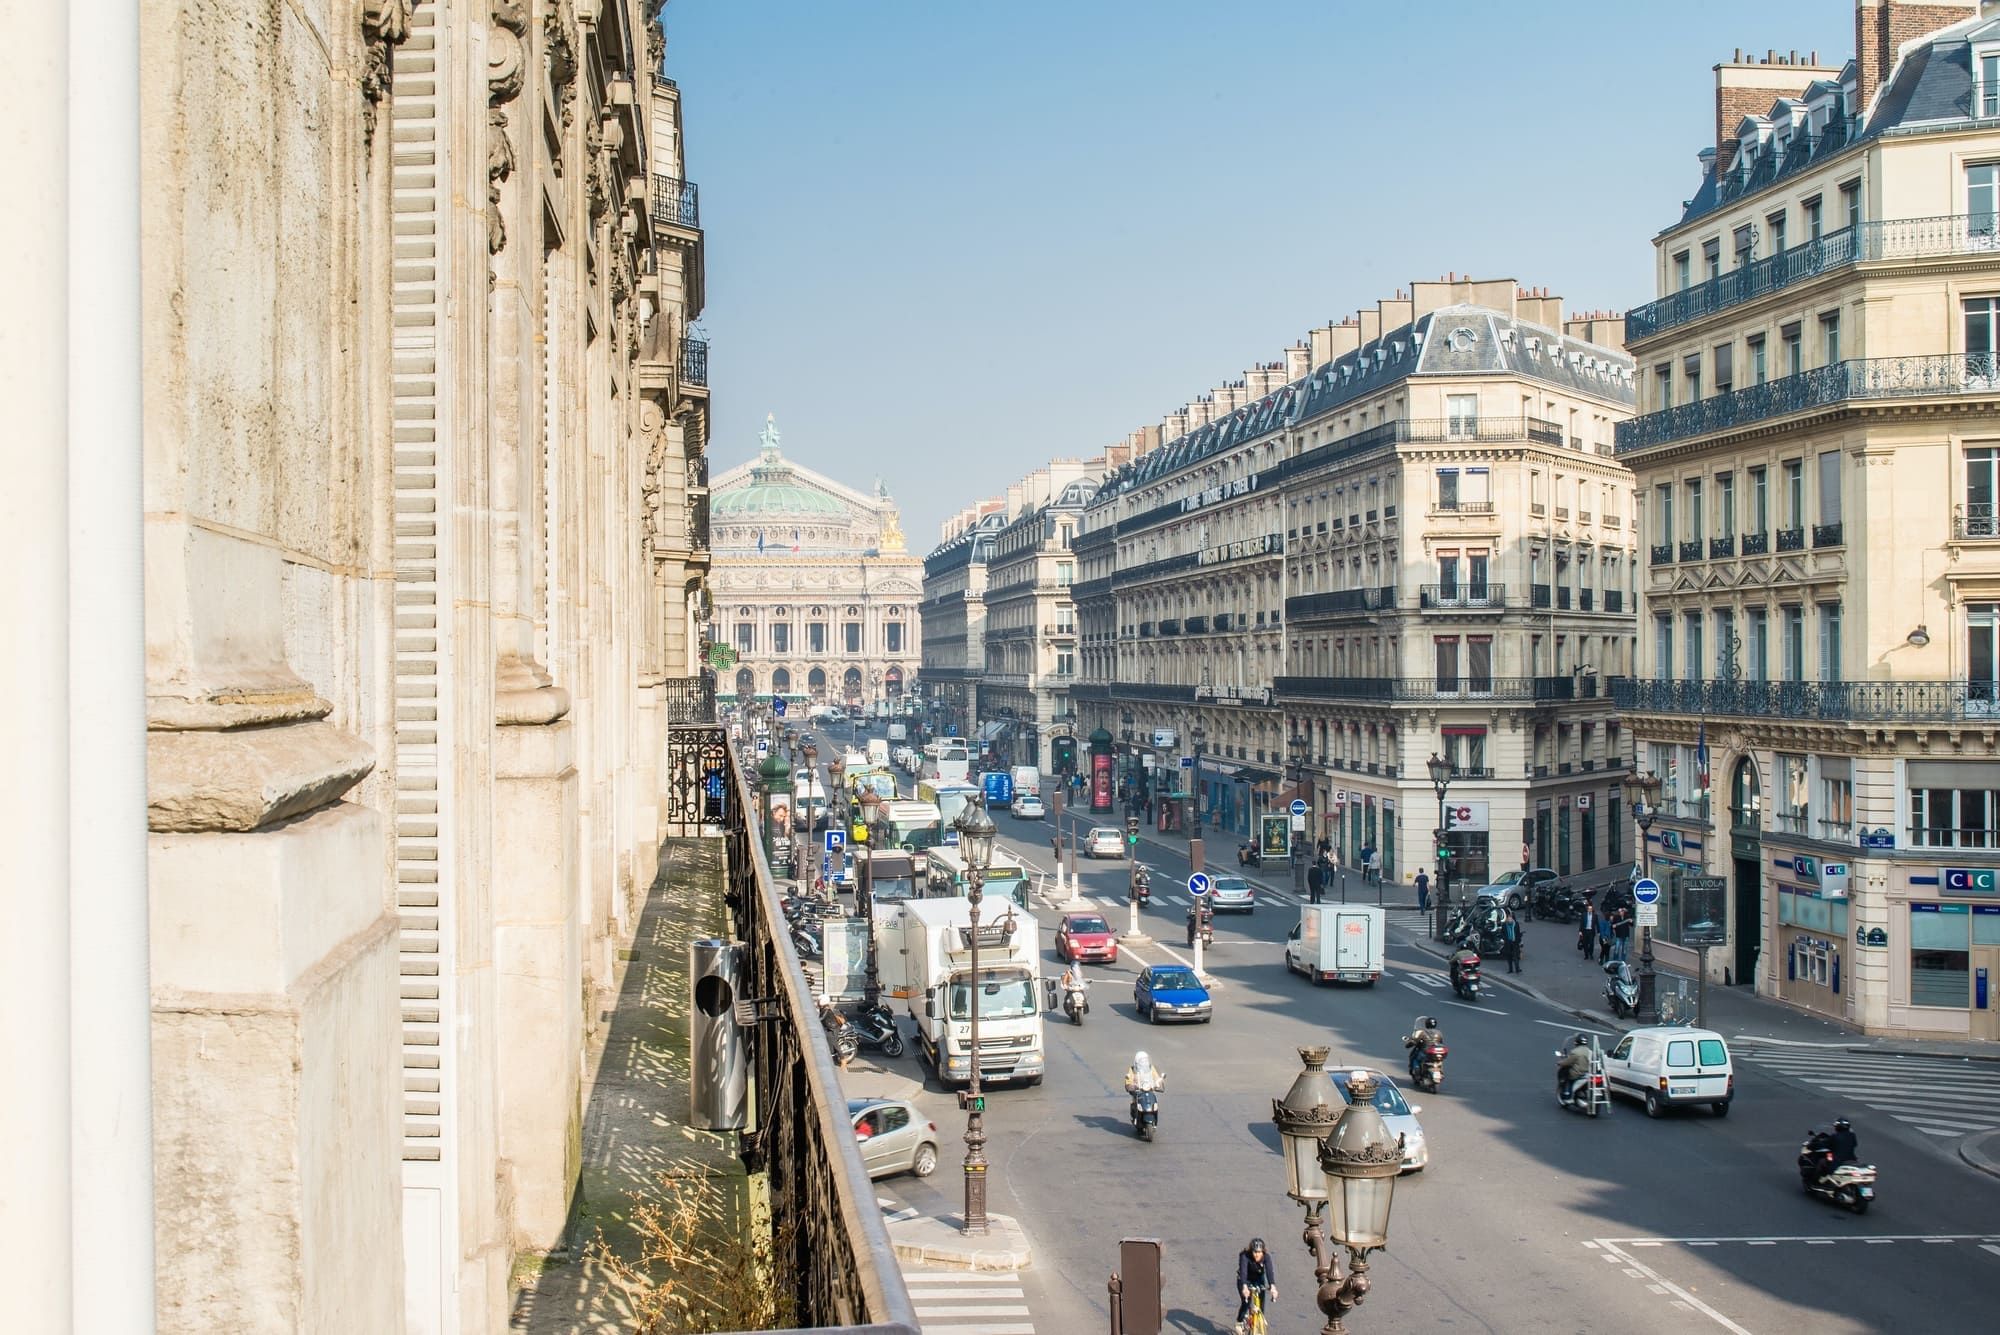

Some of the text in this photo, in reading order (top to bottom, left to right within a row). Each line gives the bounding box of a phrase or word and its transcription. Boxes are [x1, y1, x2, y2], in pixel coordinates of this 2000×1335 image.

[831, 834, 841, 849] P
[1827, 866, 1845, 874] CIC
[1683, 879, 1724, 888] BILL VIOLA
[1950, 873, 1990, 888] CIC
